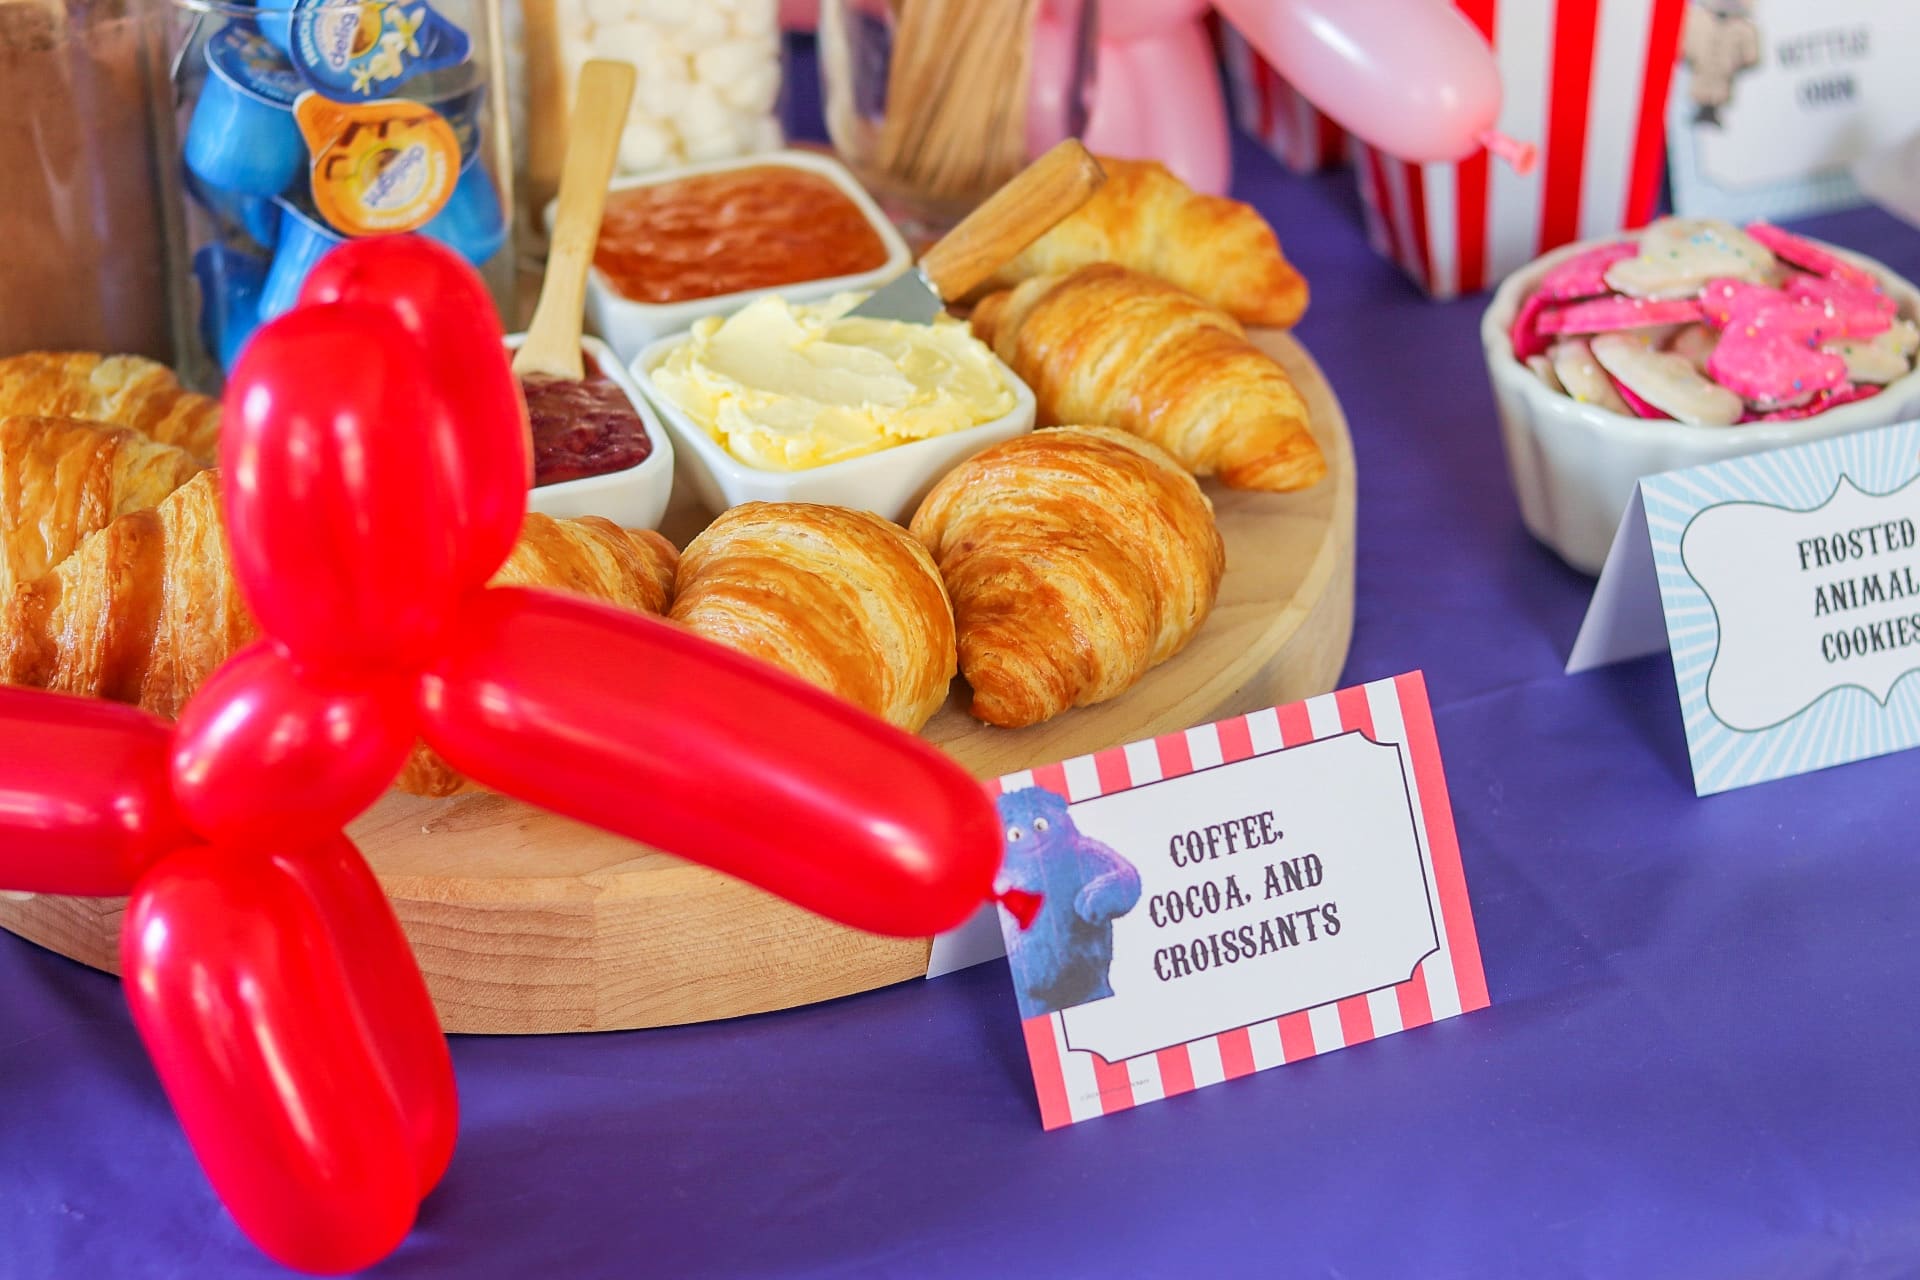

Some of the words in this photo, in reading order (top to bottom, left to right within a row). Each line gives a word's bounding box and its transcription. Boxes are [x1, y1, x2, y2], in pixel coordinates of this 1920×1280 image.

[1797, 517, 1916, 571] FROSTED
[1814, 565, 1920, 617] ANIMAL
[1821, 613, 1920, 664] COOKIES
[1169, 811, 1283, 868] COFFEE,
[1149, 874, 1251, 928] COCOA,
[1263, 853, 1323, 900] AND
[1153, 901, 1341, 982] CROISSANTS
